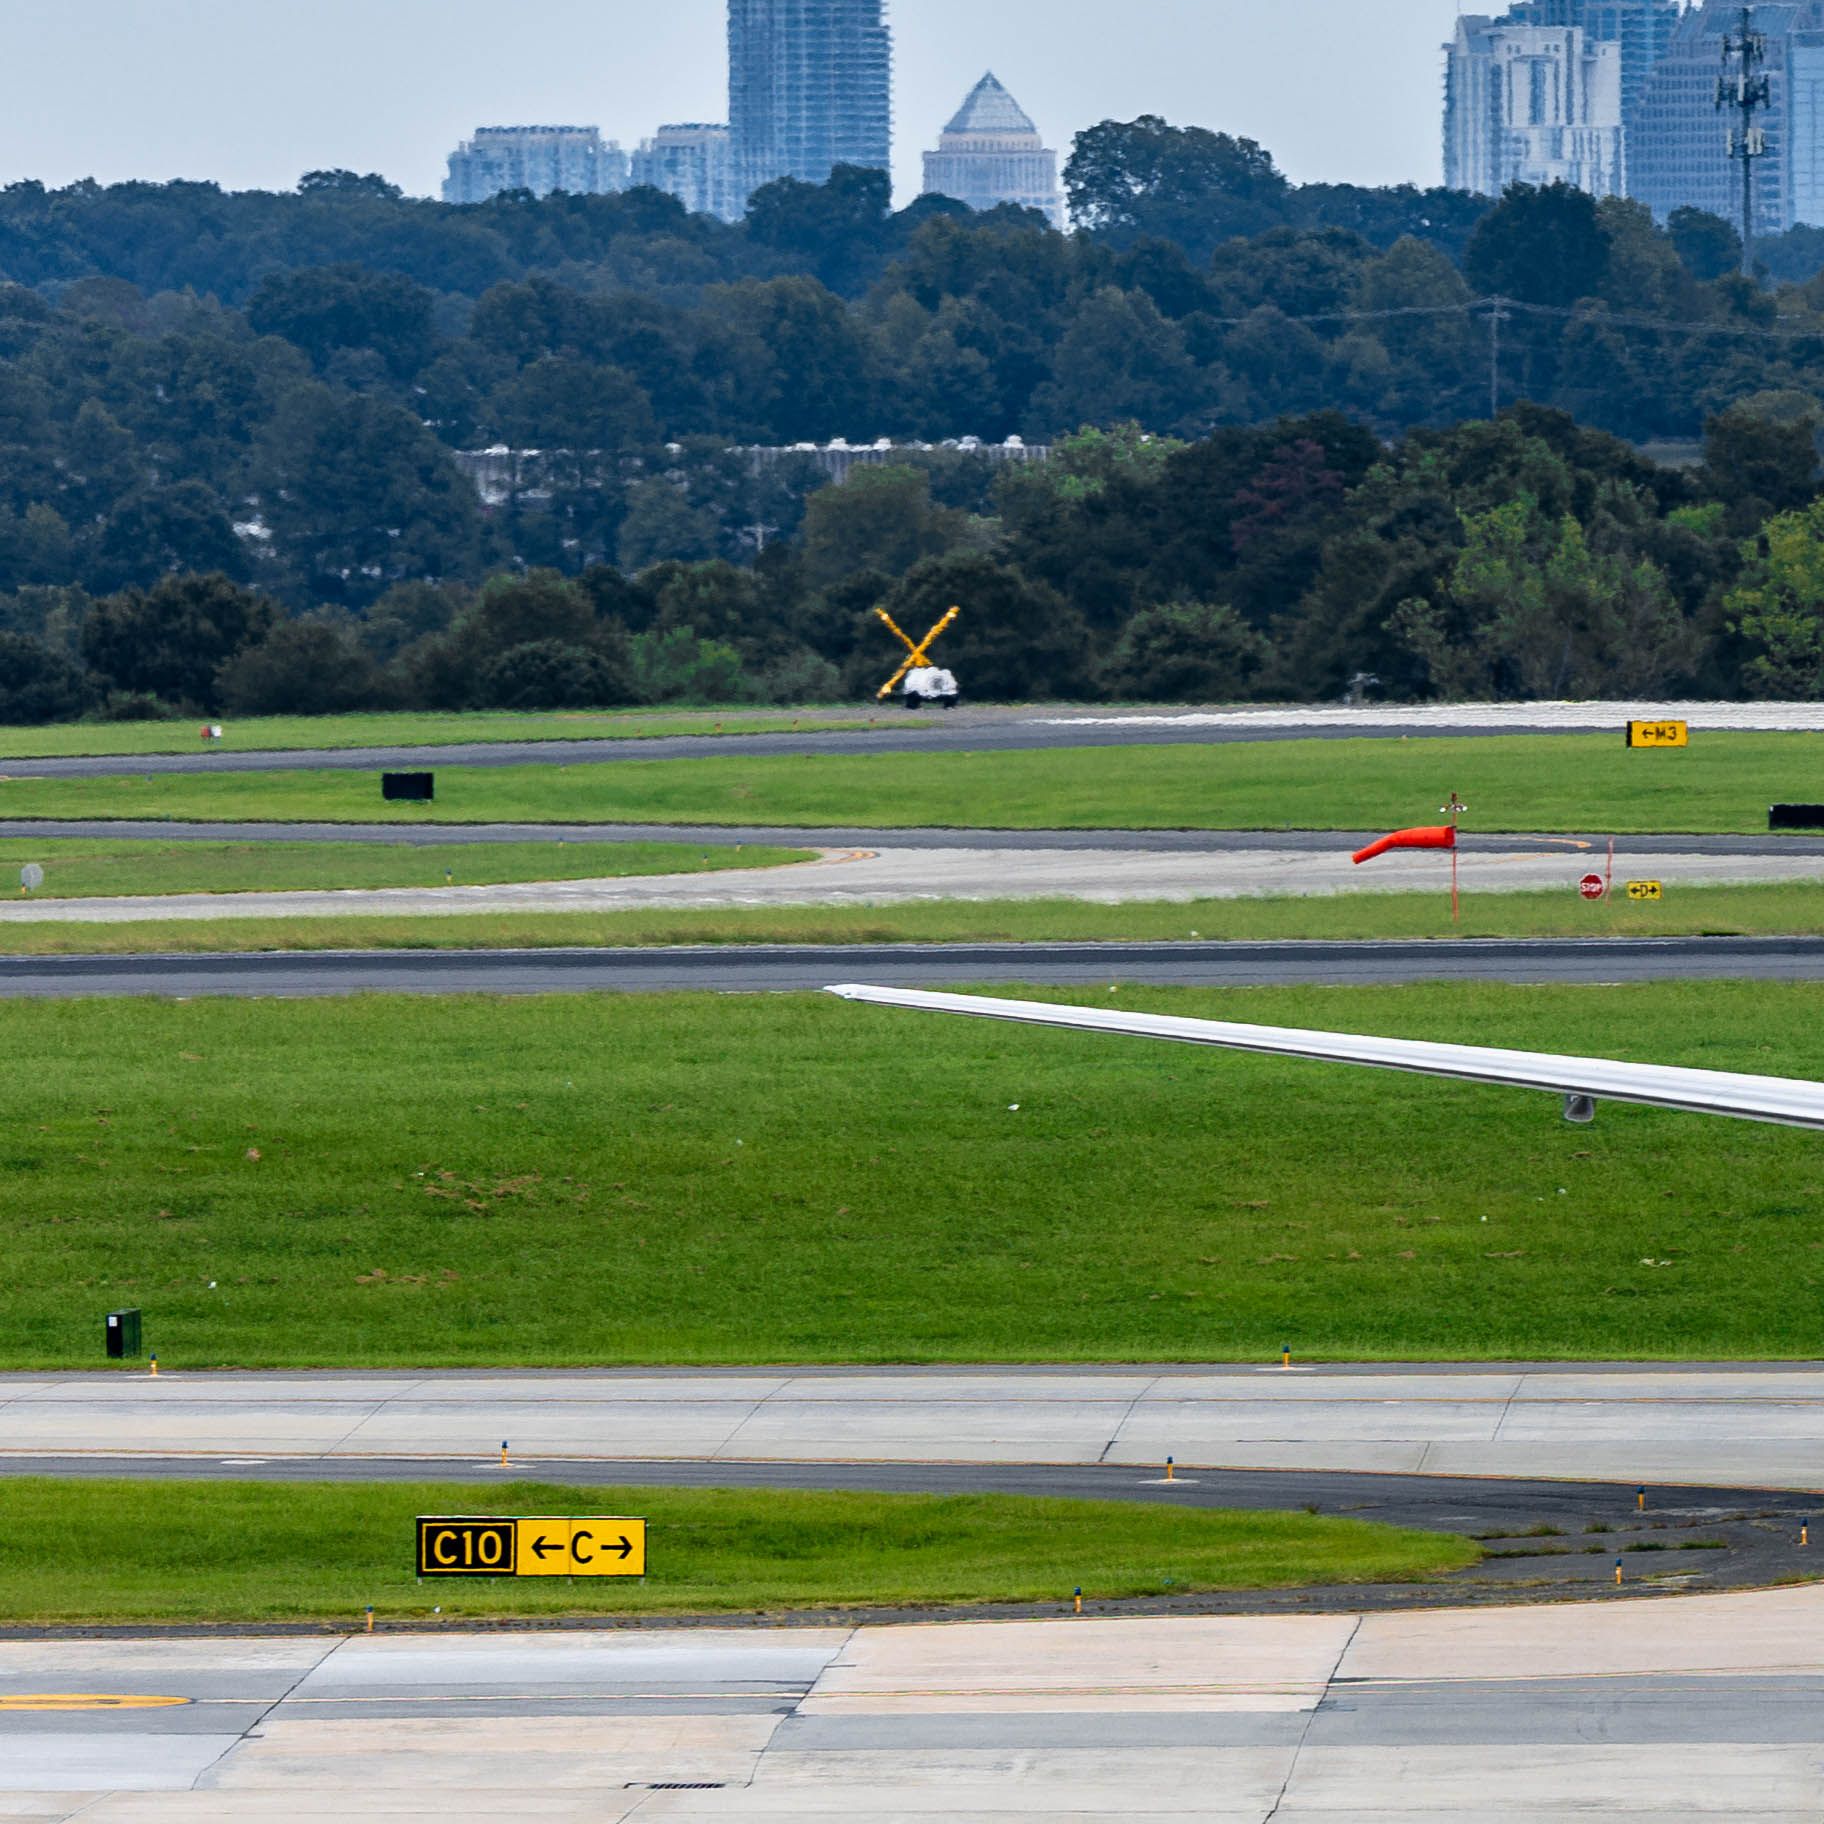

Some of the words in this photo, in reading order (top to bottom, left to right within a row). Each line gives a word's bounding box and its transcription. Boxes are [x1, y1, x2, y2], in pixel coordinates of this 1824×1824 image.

[1655, 726, 1677, 741] M3
[1581, 882, 1602, 893] STOP
[433, 1530, 502, 1565] C10
[571, 1530, 594, 1565] C
